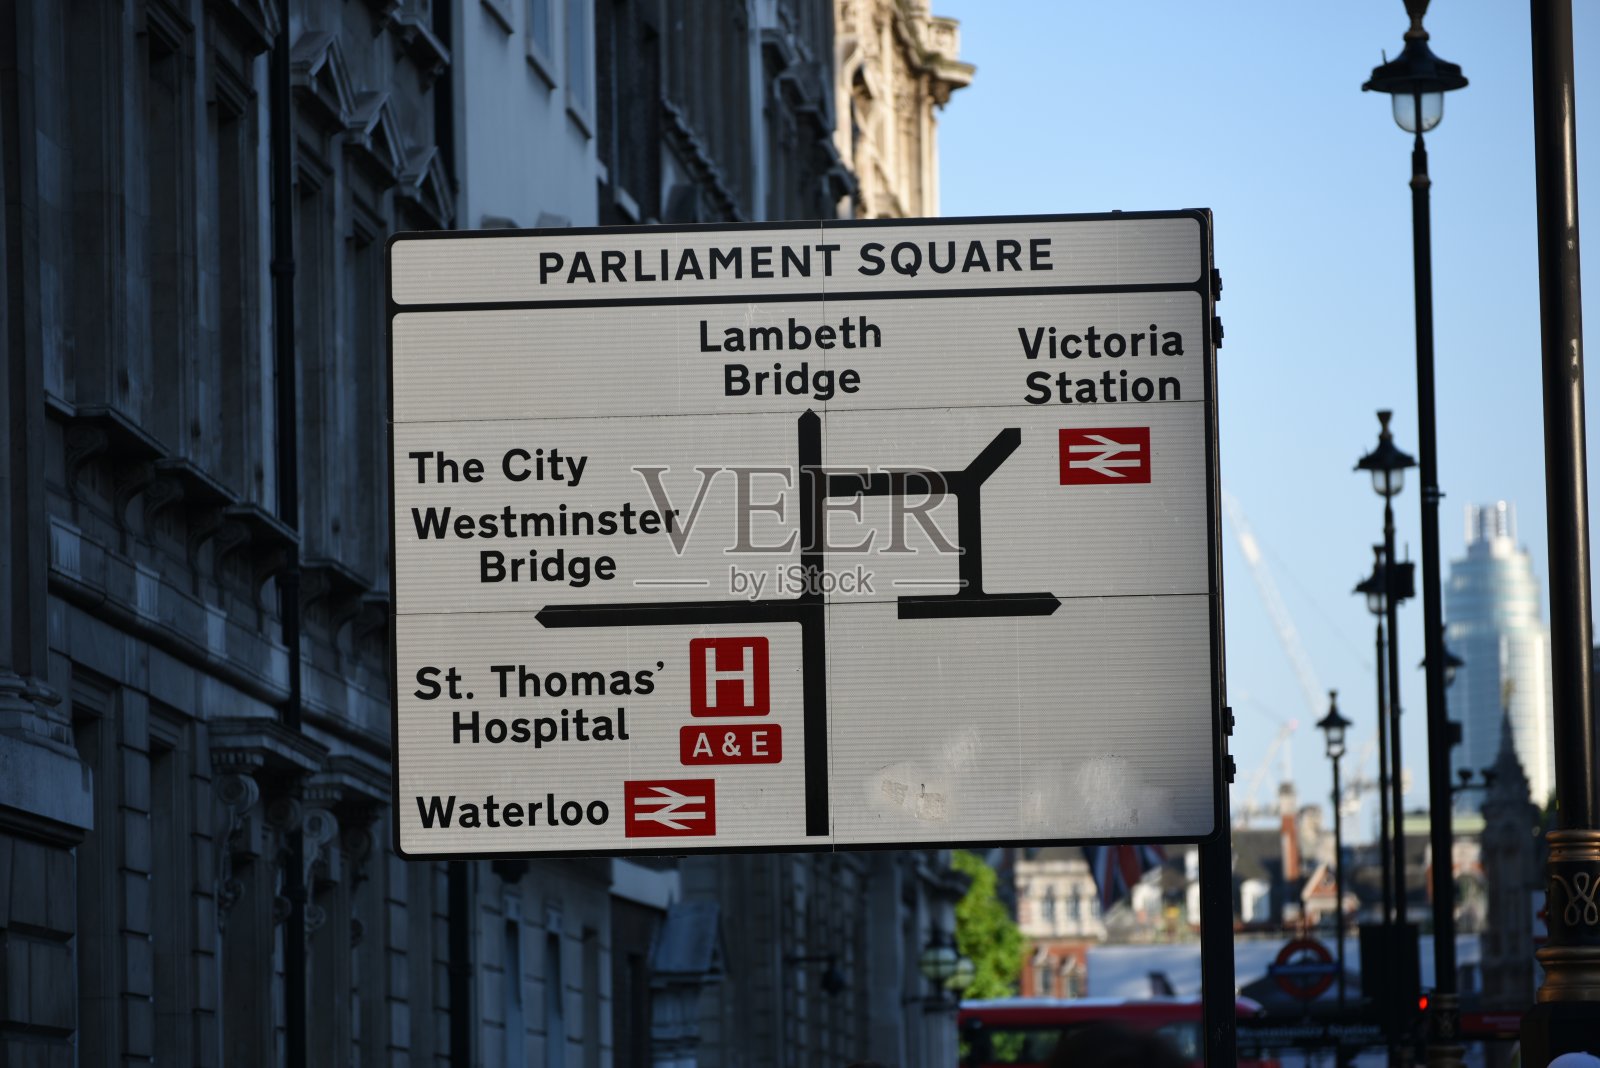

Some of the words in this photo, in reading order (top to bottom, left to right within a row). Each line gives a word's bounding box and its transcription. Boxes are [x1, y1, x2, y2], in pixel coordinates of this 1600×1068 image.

[540, 245, 840, 284] PARLIAMENT
[858, 239, 1053, 277] SQUARE
[700, 318, 881, 352] Lambeth
[1018, 324, 1184, 359] Victoria
[725, 362, 860, 401] Bridge
[1025, 370, 1181, 404] Station
[409, 451, 484, 483] The
[502, 447, 587, 486] City
[412, 503, 679, 539] Westminster
[481, 549, 616, 587] Bridge
[414, 667, 473, 700] St.
[705, 646, 754, 707] H
[453, 708, 629, 748] Hospital
[416, 794, 609, 828] Waterloo
